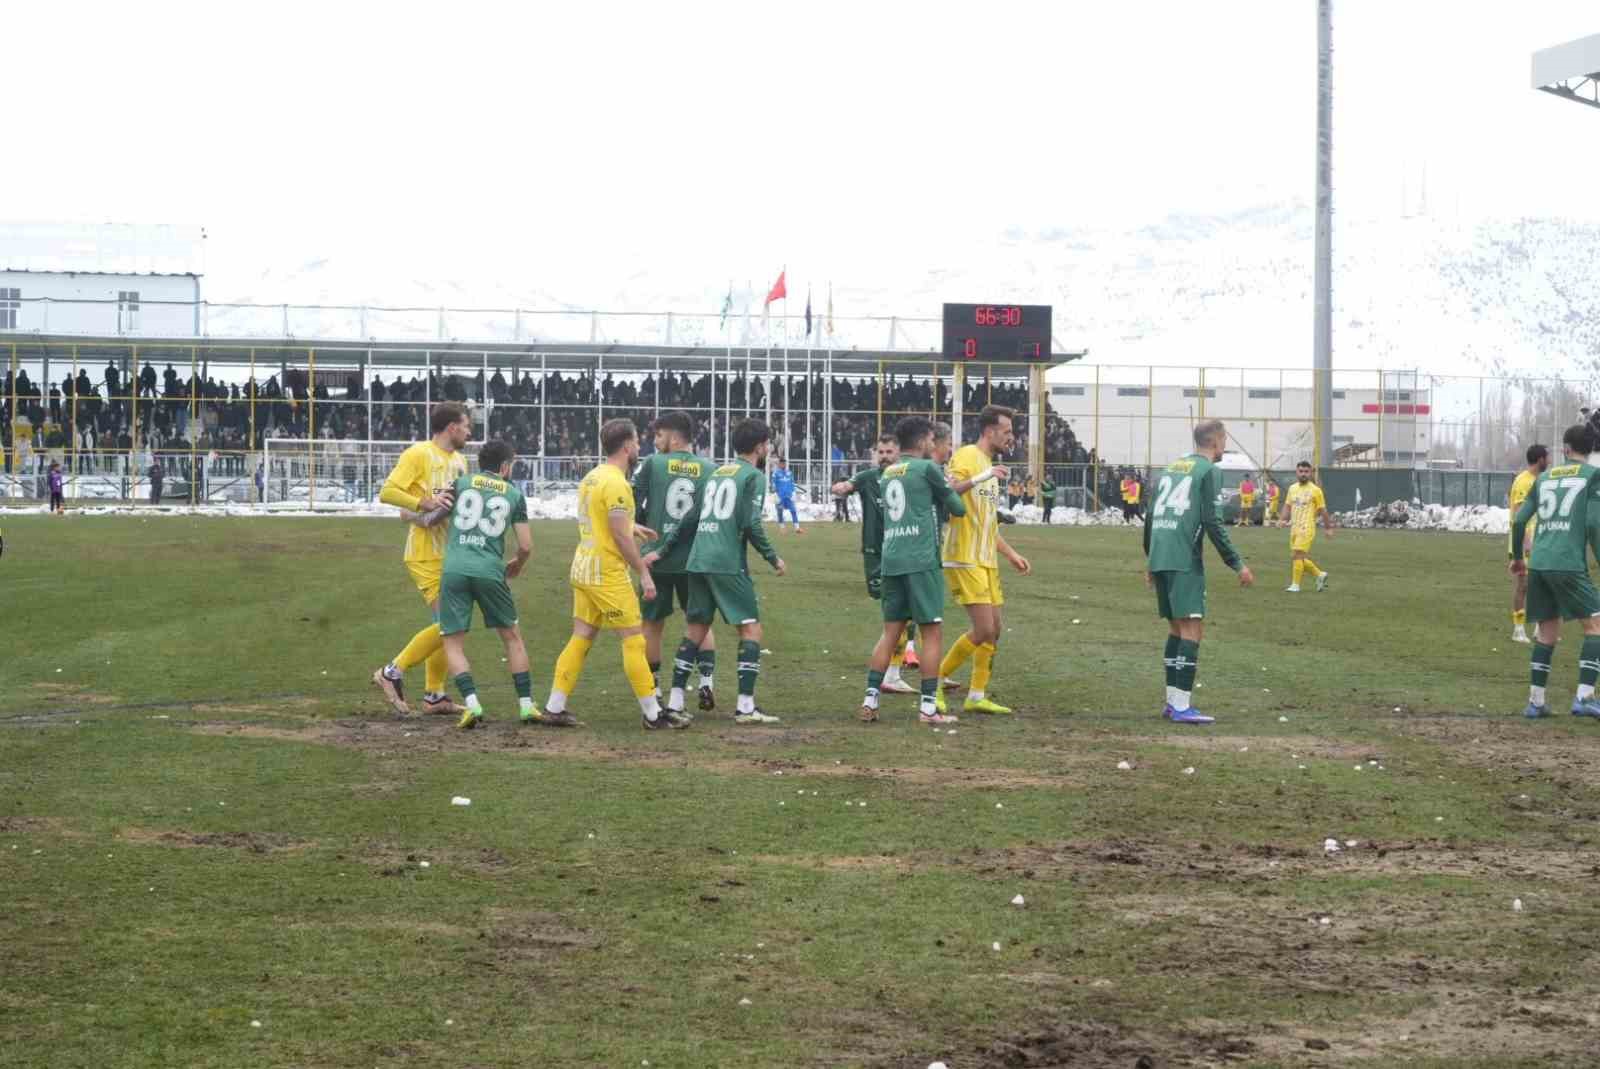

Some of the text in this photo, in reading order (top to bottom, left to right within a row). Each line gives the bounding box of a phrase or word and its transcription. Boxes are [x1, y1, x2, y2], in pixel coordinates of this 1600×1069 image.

[965, 338, 977, 358] 0
[453, 488, 511, 538] 93
[665, 477, 696, 521] 6
[885, 478, 906, 522] 9
[1153, 475, 1193, 517] 24
[1538, 479, 1587, 519] 57
